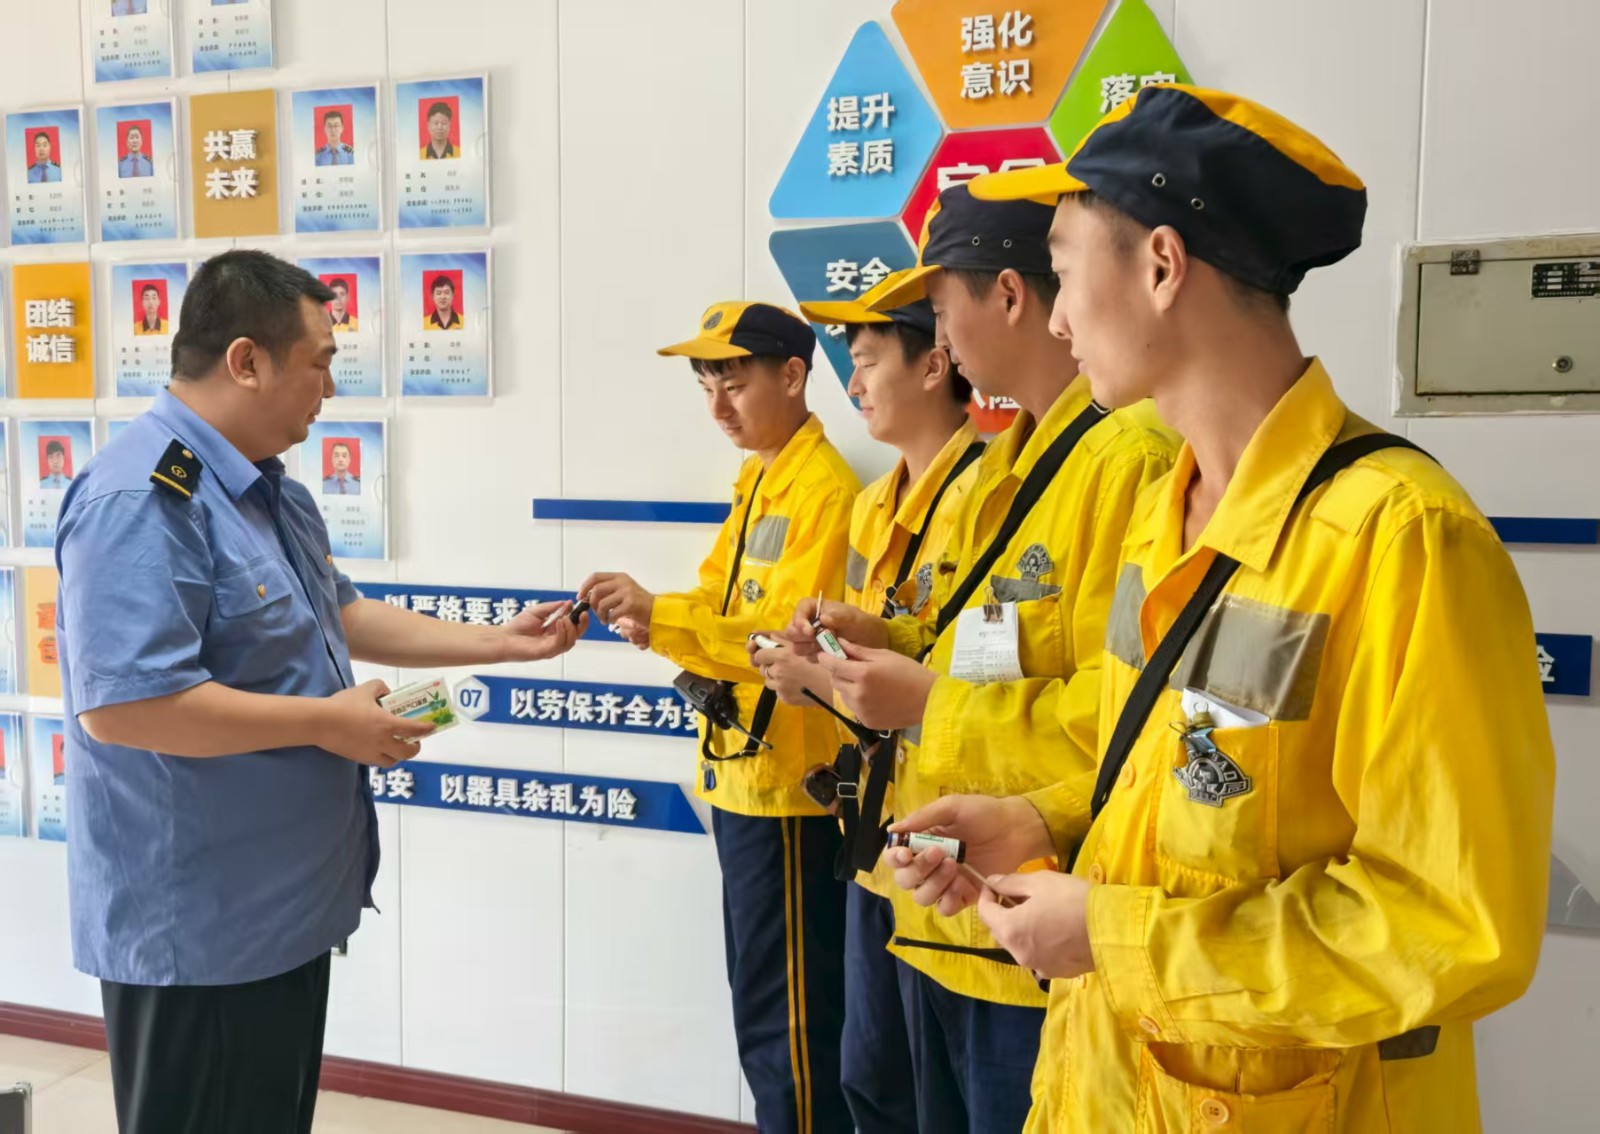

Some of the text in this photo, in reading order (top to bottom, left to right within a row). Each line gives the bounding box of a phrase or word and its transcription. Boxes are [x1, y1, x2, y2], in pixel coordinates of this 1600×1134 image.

[961, 11, 1033, 53] 强化
[960, 59, 1031, 98] 意识
[827, 93, 895, 132] 提升
[204, 129, 257, 161] 共赢
[827, 139, 894, 176] 素质
[205, 167, 258, 199] 未来
[25, 298, 75, 327] 团结
[25, 334, 76, 363] 诚信
[459, 689, 482, 708] 07
[440, 774, 637, 820] 以器具杂乱为险
